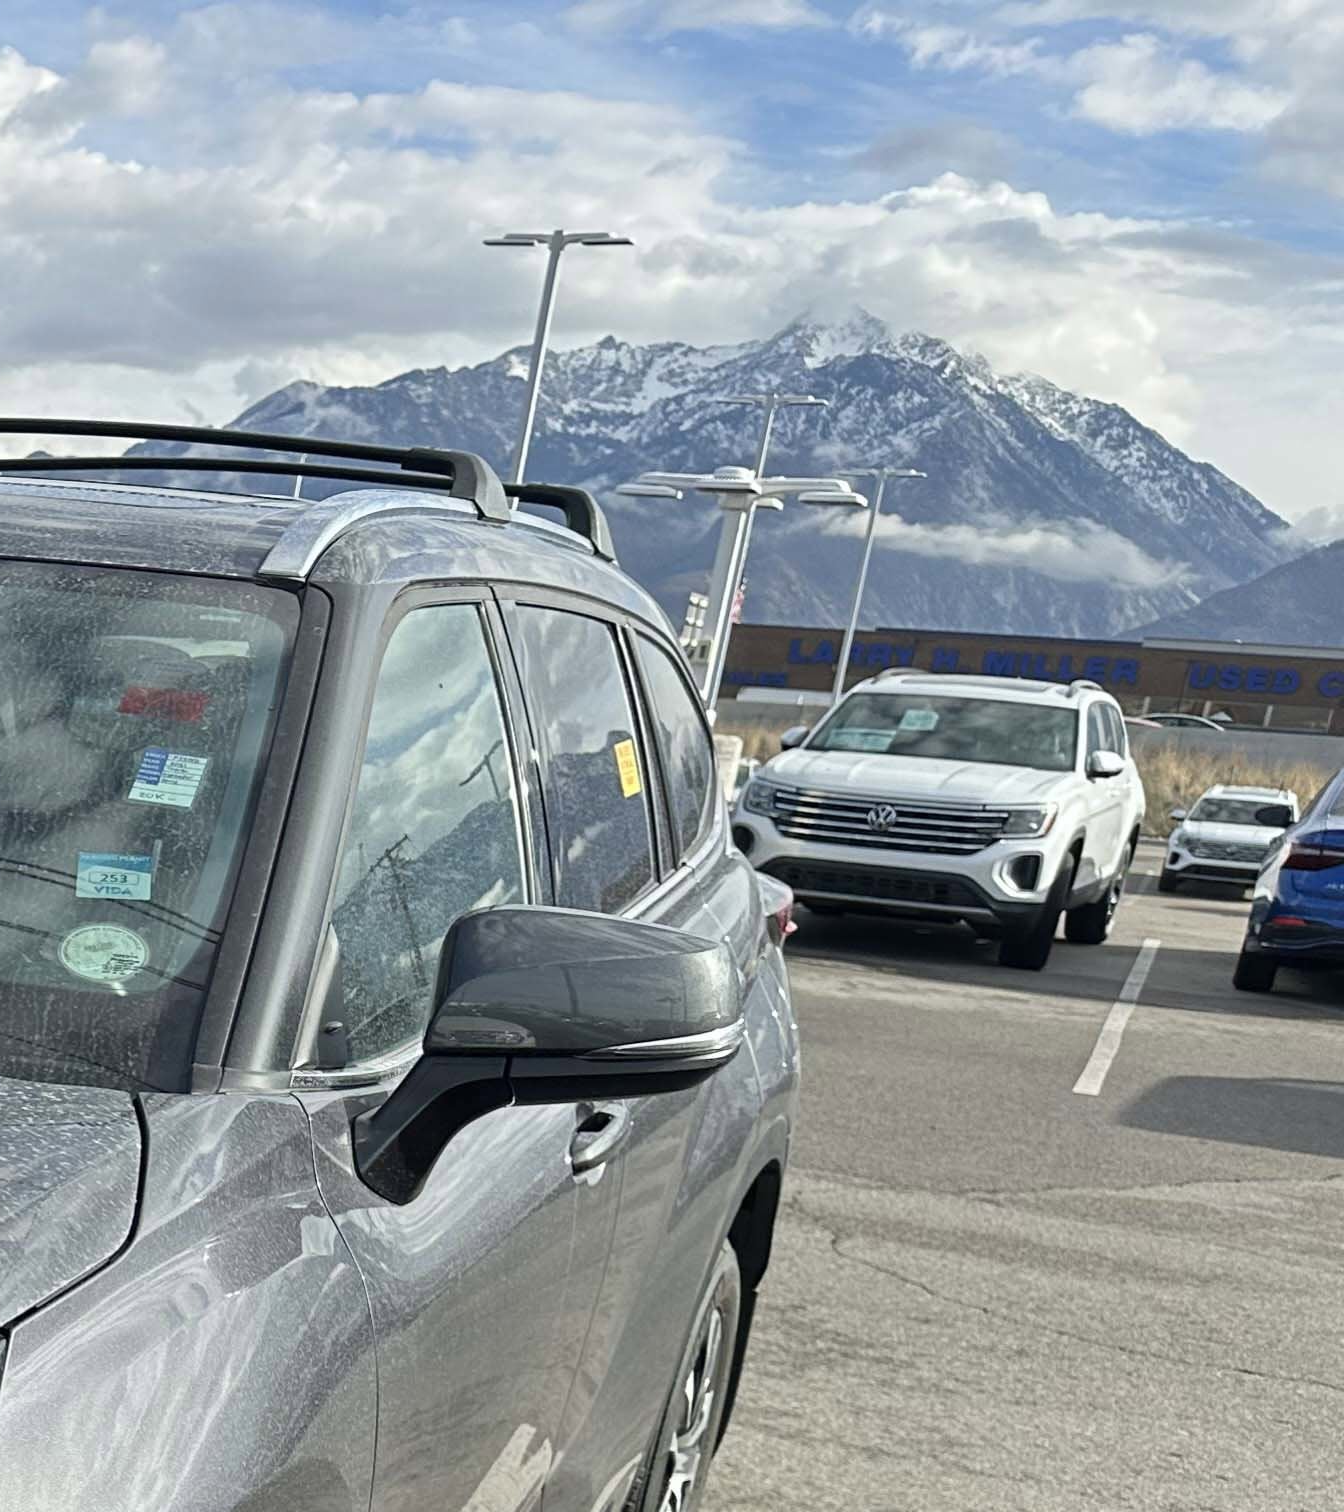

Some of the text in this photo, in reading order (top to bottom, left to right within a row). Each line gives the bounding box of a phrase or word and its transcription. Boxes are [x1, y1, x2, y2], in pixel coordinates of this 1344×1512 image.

[982, 649, 1140, 685] MILLER
[1190, 661, 1300, 694] USED
[99, 873, 129, 884] 253
[93, 886, 132, 897] VIDA
